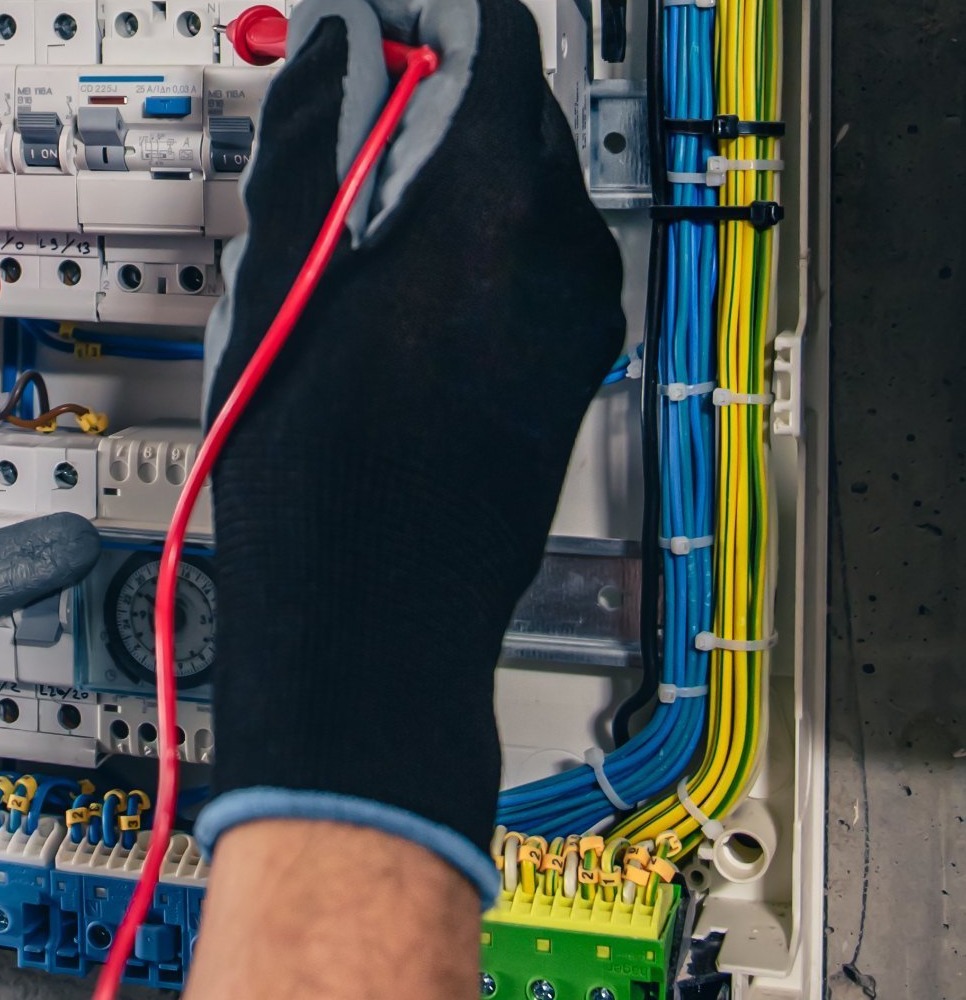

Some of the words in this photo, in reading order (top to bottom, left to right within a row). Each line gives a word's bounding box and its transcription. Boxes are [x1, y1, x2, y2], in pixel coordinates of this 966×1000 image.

[208, 3, 216, 12] N
[136, 84, 146, 93] 25
[190, 84, 197, 93] A
[41, 149, 58, 158] ON
[235, 154, 251, 164] ON
[171, 448, 180, 461] 9
[530, 851, 540, 861] 2
[552, 858, 563, 868] 2
[582, 872, 594, 880] 2
